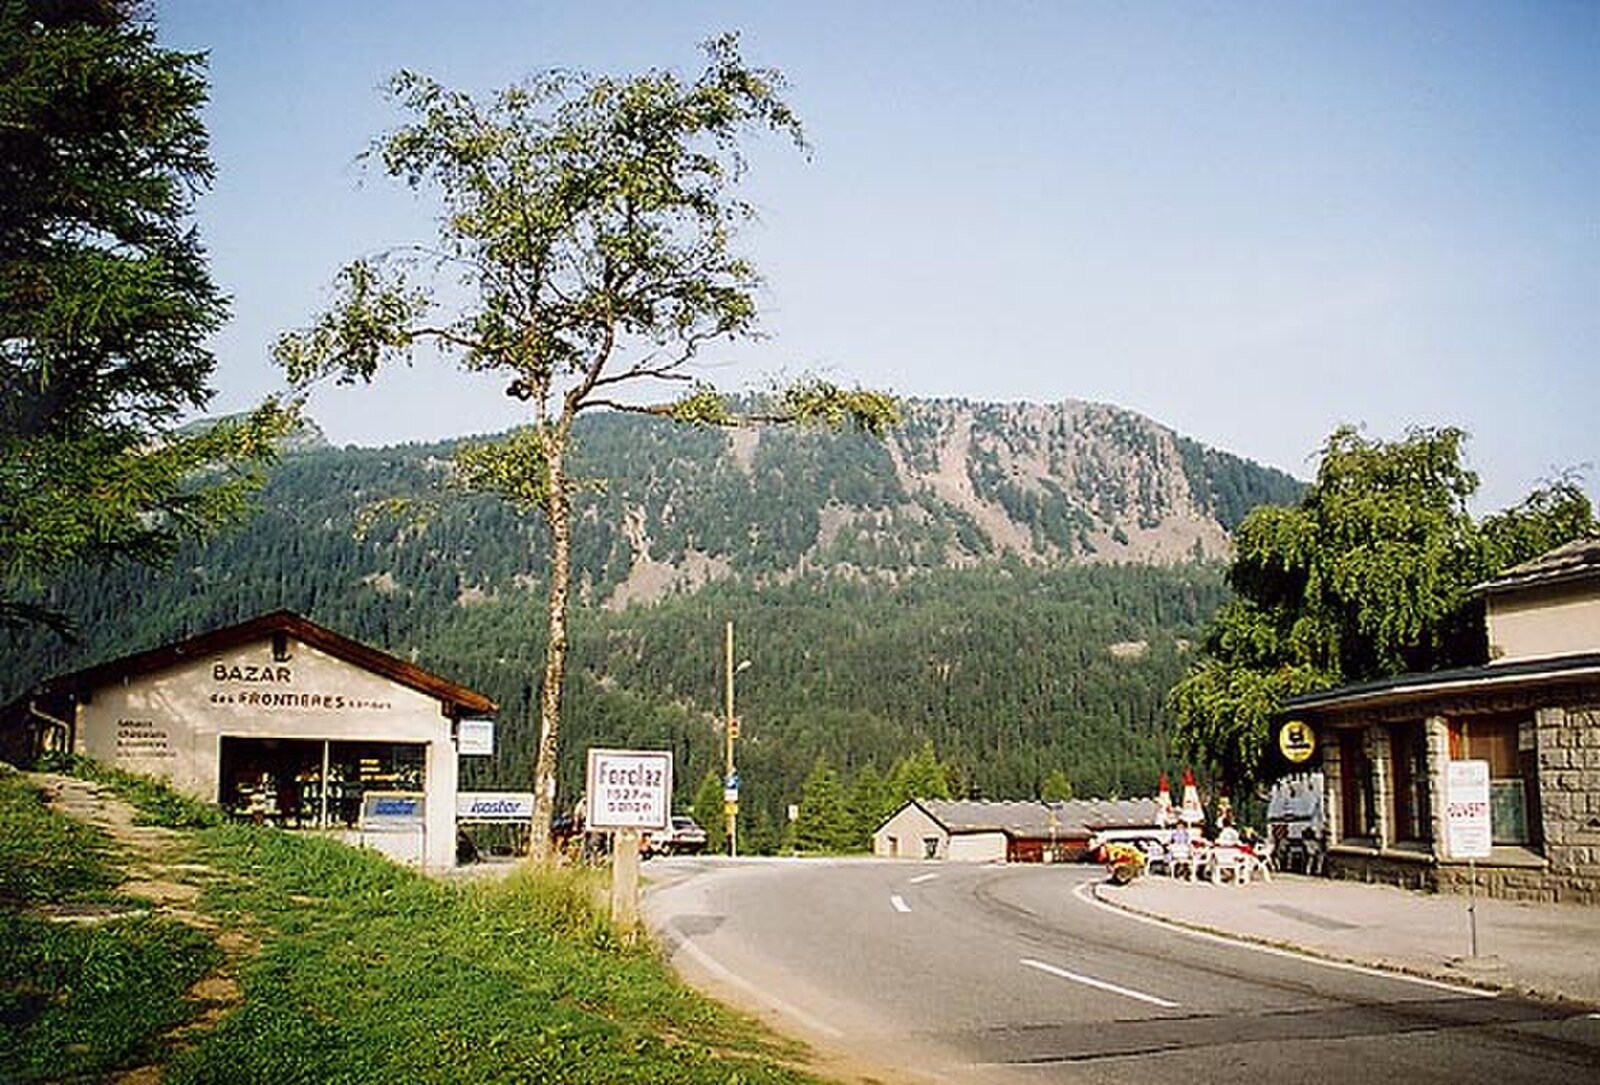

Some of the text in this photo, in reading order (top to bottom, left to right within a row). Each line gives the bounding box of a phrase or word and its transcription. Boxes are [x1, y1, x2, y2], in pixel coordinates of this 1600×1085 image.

[213, 664, 292, 683] BAZAR
[599, 761, 662, 787] Forclaz
[471, 799, 522, 814] isostar
